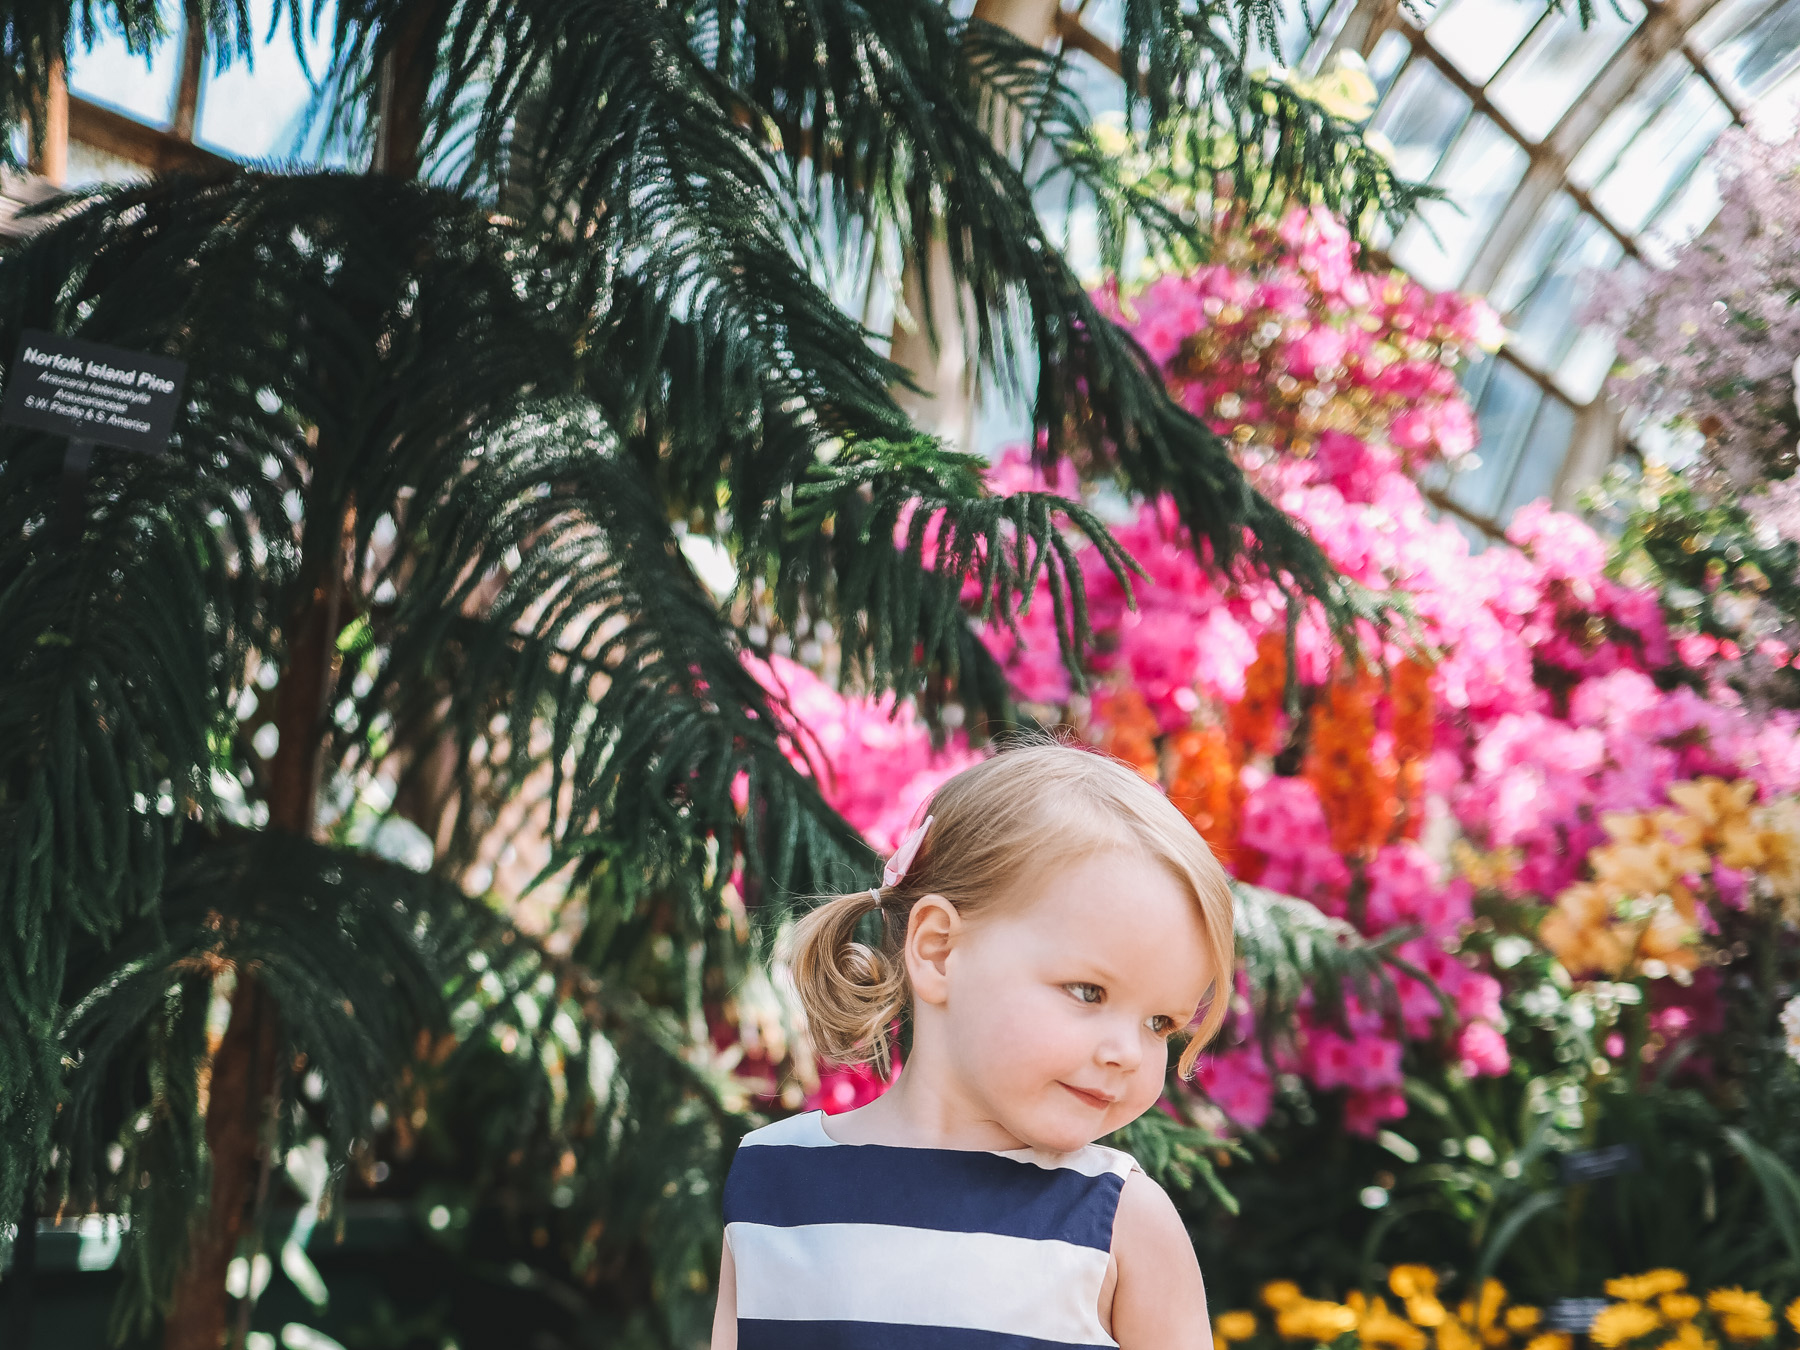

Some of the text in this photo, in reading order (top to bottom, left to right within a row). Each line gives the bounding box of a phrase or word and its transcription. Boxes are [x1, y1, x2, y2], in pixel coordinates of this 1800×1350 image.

[23, 347, 175, 394] Norfolk Island Pine
[37, 371, 90, 392] Araucaria
[49, 400, 85, 419] Pacific
[84, 408, 94, 420] &
[106, 413, 151, 433] America
